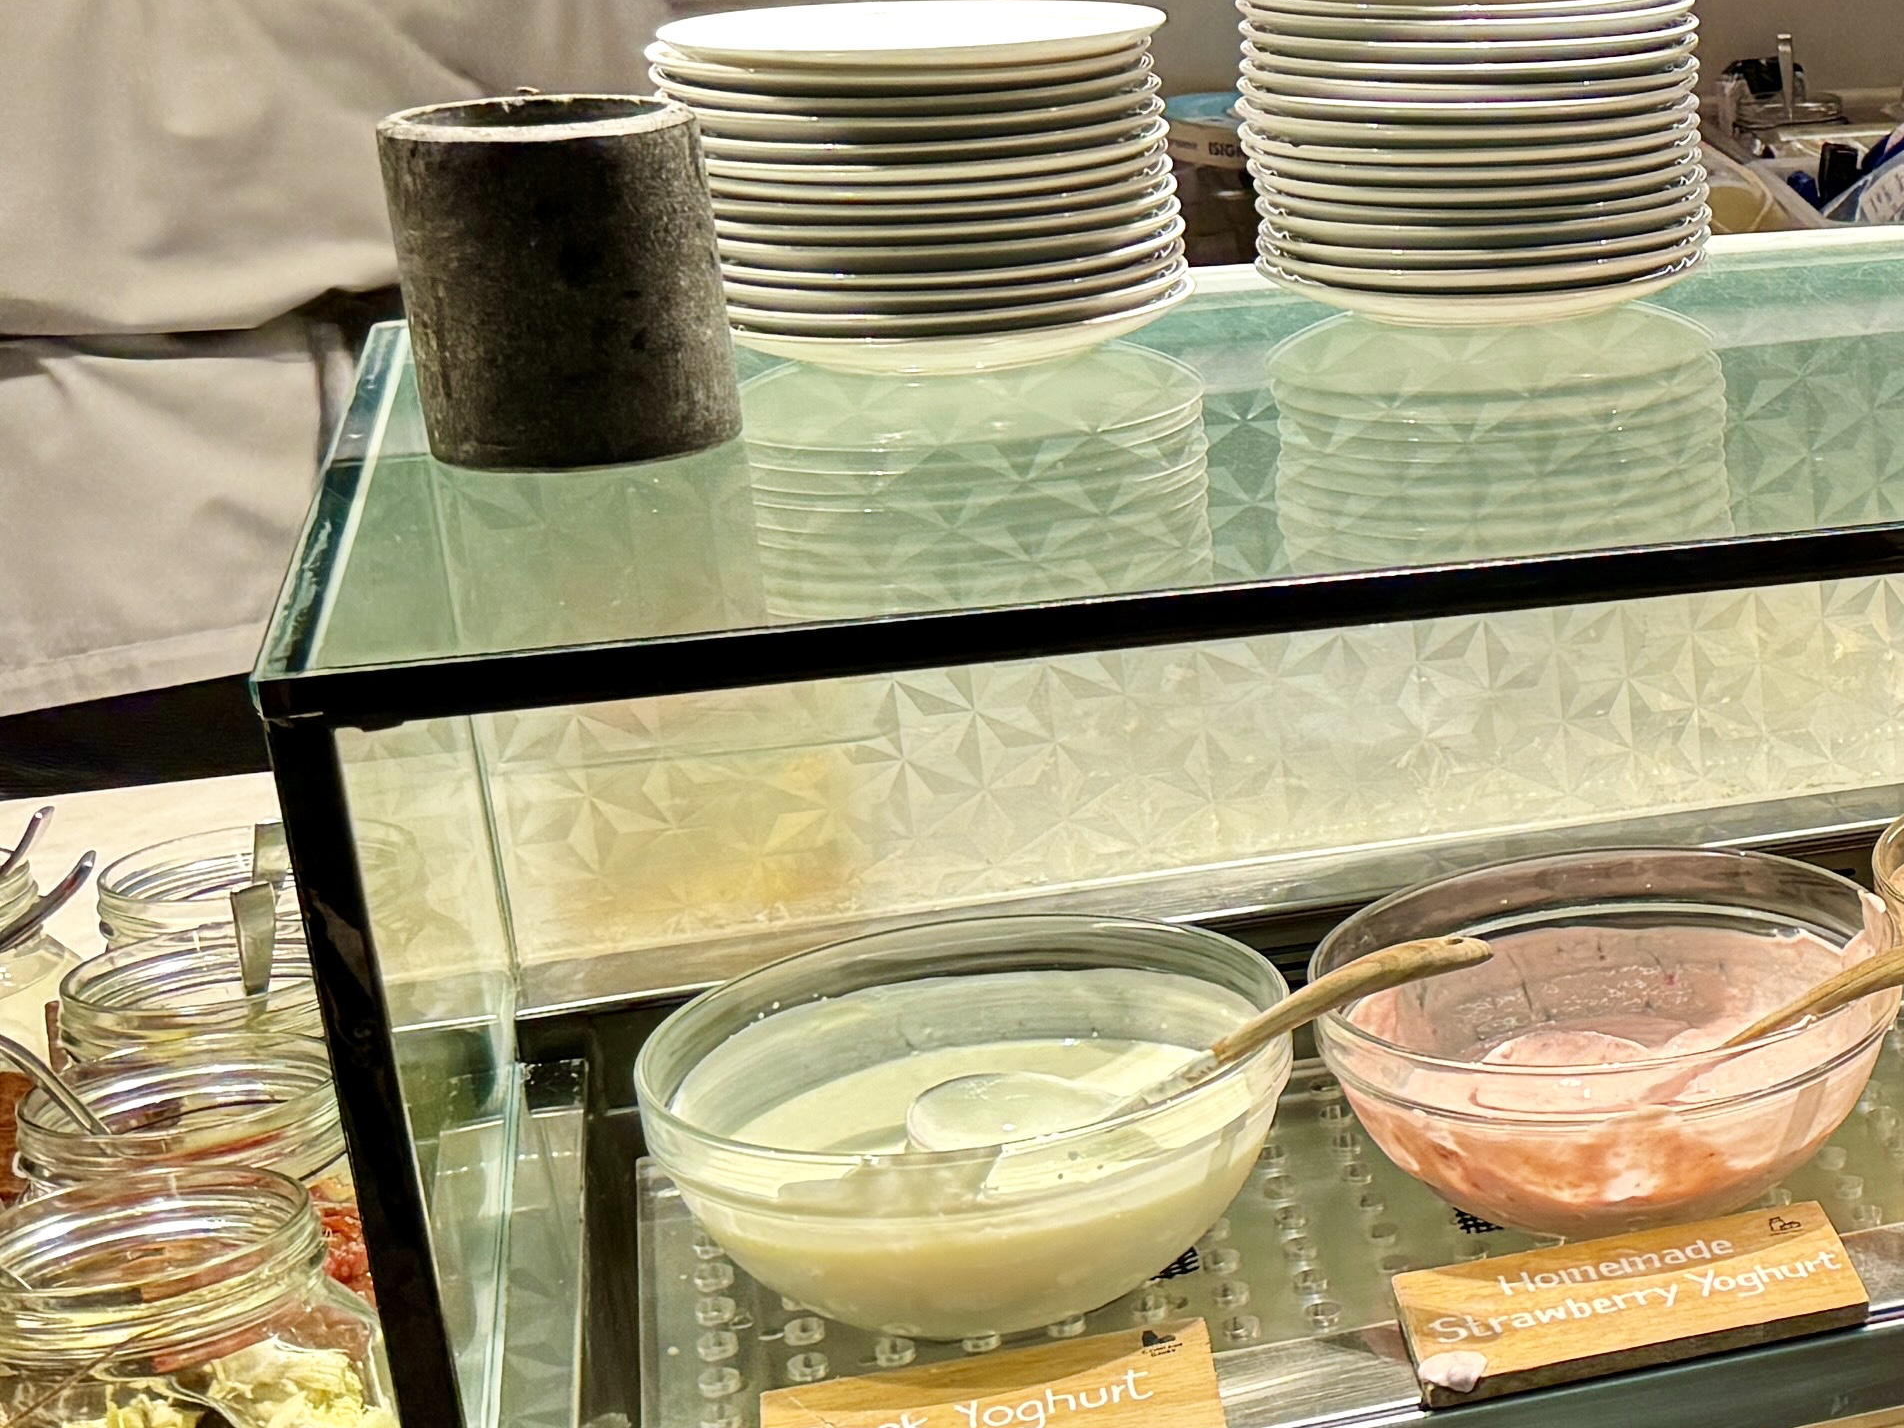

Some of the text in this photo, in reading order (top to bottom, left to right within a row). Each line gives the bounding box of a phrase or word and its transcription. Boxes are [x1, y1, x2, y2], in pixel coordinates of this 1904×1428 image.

[1429, 1249, 1842, 1345] Strawberry Yoghurt
[1496, 1236, 1735, 1298] Homemade
